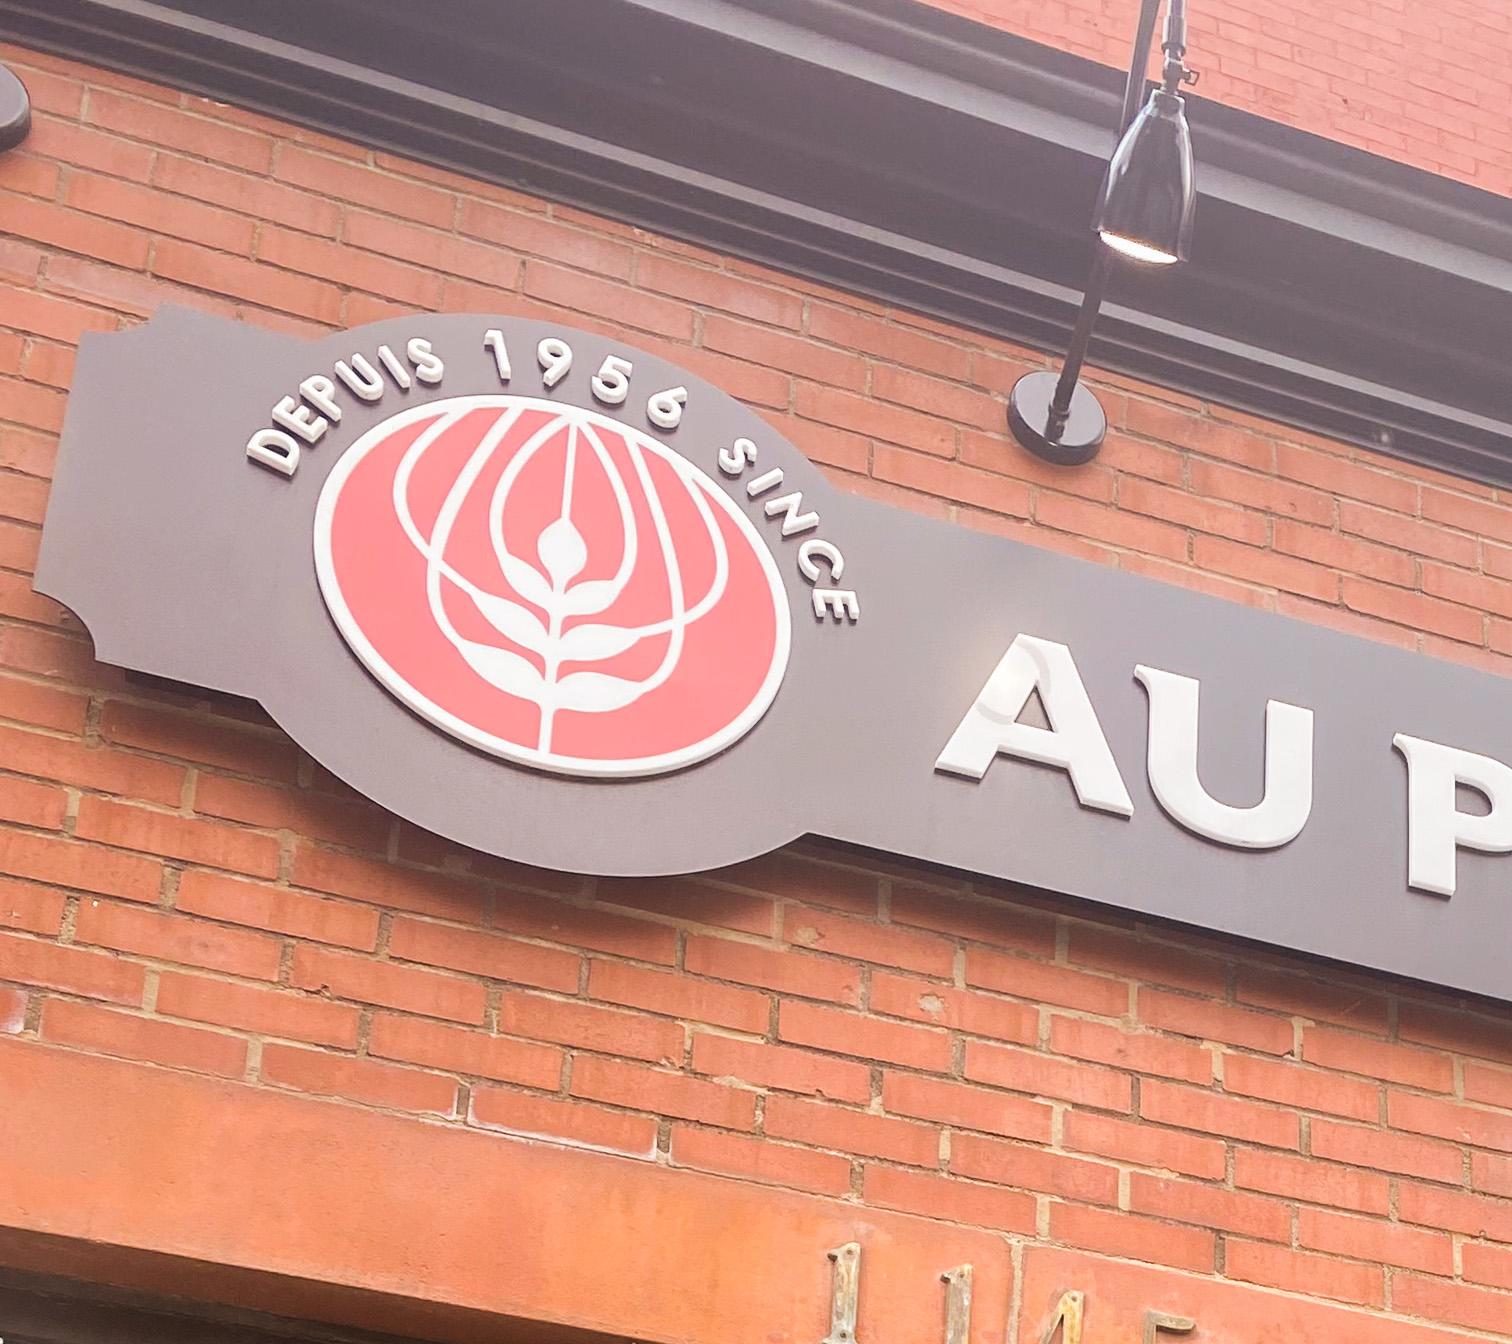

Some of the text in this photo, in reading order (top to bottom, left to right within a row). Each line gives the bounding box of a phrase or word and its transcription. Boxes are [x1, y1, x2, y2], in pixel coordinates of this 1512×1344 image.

[246, 329, 860, 622] DEPUIS 1956 SINCE
[934, 632, 1315, 851] AU
